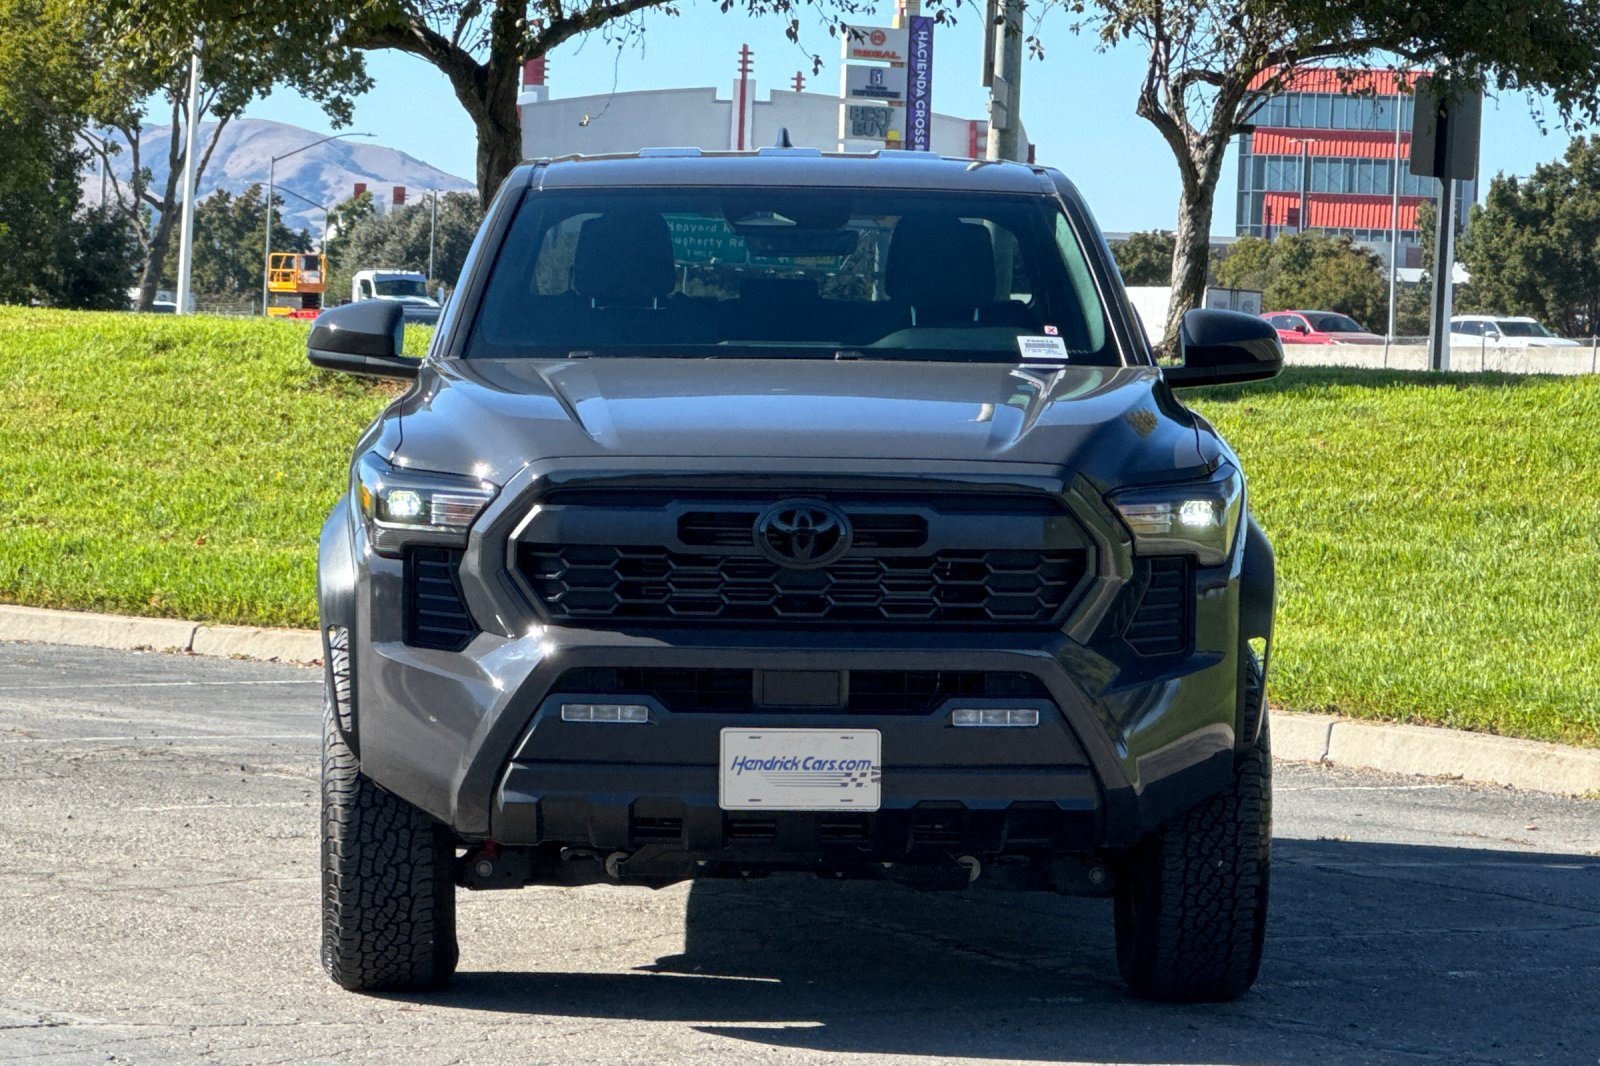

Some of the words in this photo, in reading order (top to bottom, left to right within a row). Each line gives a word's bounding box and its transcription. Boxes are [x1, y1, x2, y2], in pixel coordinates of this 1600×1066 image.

[915, 31, 928, 97] HACIENDA
[850, 107, 894, 121] BEST
[852, 121, 889, 137] BUY
[672, 237, 722, 248] ugherty
[729, 238, 745, 247] Rd
